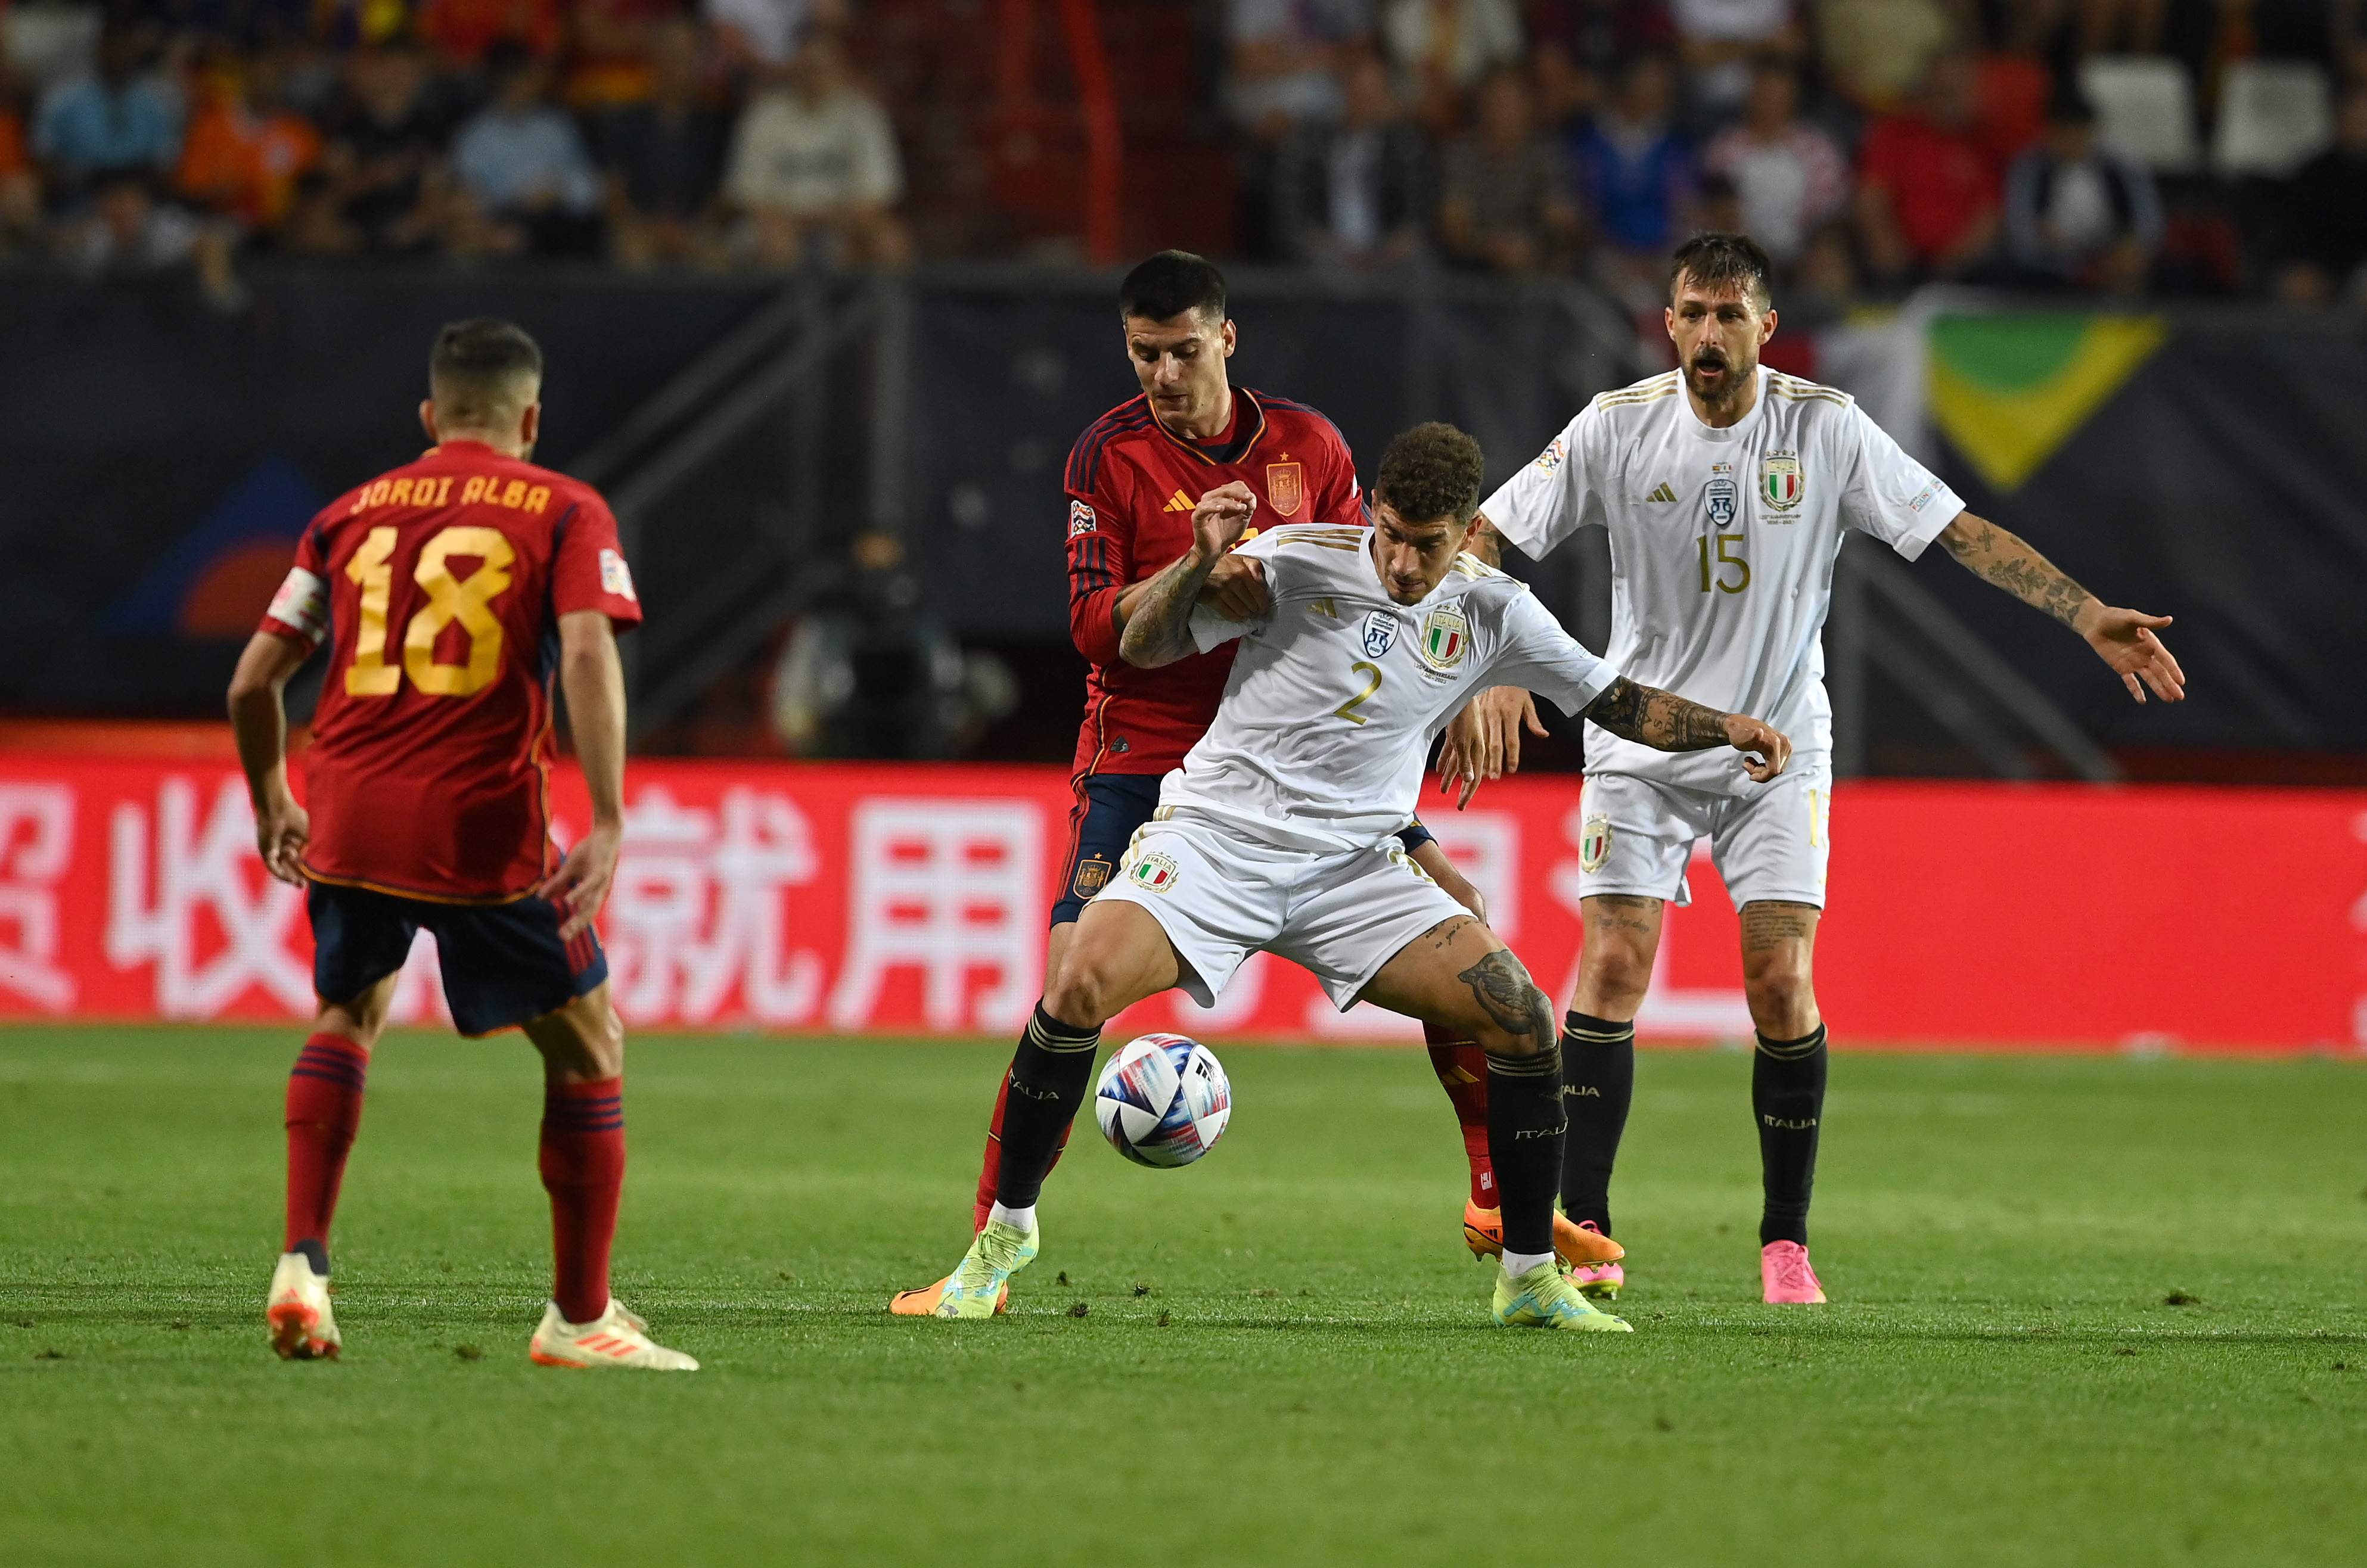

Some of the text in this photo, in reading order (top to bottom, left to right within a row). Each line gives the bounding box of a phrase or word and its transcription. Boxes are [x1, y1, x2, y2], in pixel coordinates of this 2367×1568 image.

[350, 477, 551, 515] JORDI ALBA
[1697, 534, 1750, 594] 15
[344, 525, 516, 697] 18
[1434, 614, 1461, 629] ITALIA
[1334, 661, 1382, 725] 2
[1147, 856, 1172, 871] ITALIA
[1763, 1114, 1817, 1130] ITALIA
